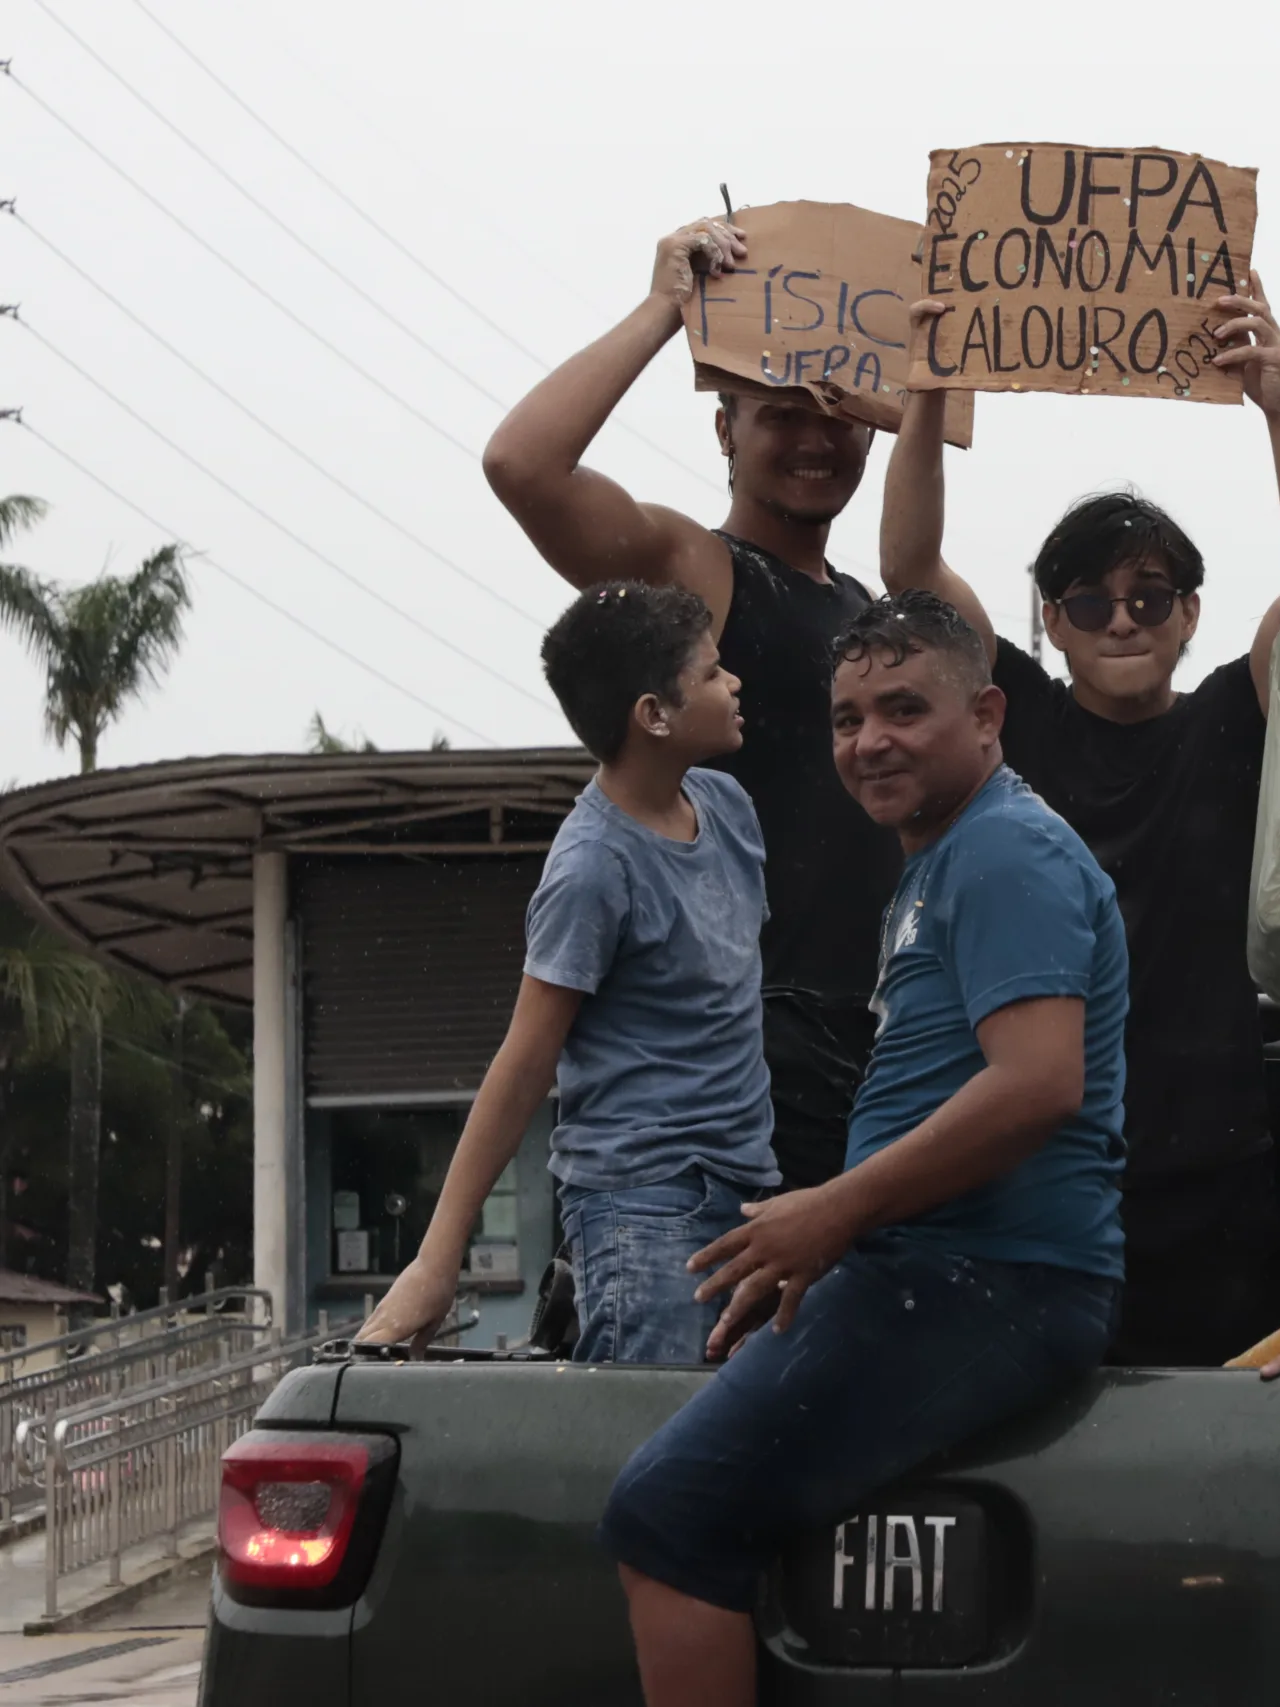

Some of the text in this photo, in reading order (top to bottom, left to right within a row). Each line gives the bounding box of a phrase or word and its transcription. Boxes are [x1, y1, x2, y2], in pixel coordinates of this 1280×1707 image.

[928, 151, 981, 235] 2025
[1020, 149, 1228, 234] UFPA
[928, 227, 1238, 300] ECONOMIA
[696, 264, 906, 348] FÍSIC
[928, 304, 1168, 377] CALOURO
[761, 345, 881, 393] UFPA
[832, 1514, 957, 1612] FIAT
